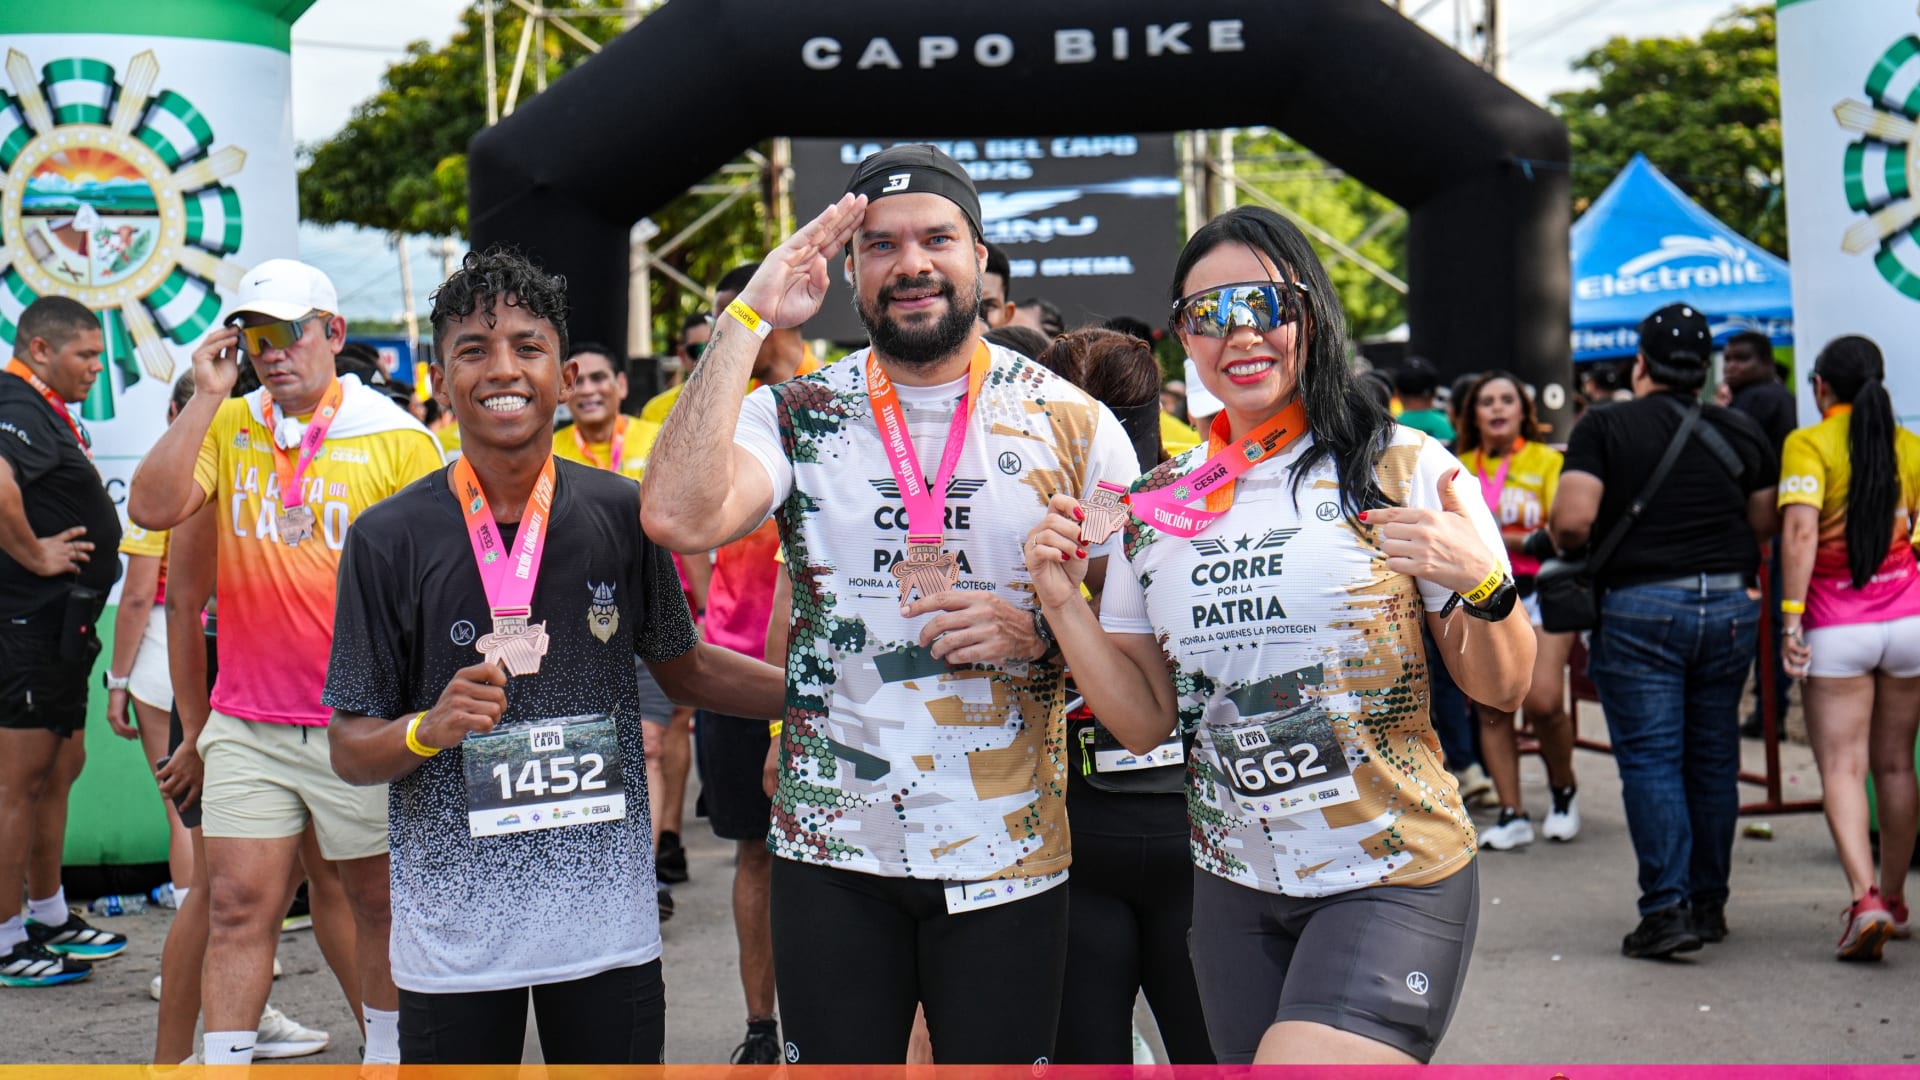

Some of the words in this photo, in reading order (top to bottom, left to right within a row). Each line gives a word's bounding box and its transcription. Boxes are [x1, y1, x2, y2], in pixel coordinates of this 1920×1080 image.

[801, 34, 1014, 70] CAPO
[1054, 19, 1245, 64] BIKE
[1050, 135, 1138, 158] CAPO
[1576, 259, 1769, 300] Electrolit
[881, 403, 908, 459] CAÑAGUATE
[234, 463, 259, 494] LA
[329, 483, 348, 498] DEL
[898, 458, 920, 497] EDICIÓN
[1194, 466, 1229, 491] CESAR
[1090, 496, 1116, 509] CAPO
[232, 493, 349, 551] CAO
[873, 506, 971, 531] CORE
[1154, 507, 1193, 531] EDICIÓN
[910, 553, 938, 563] CAPO
[1191, 553, 1284, 587] CORRE
[848, 578, 884, 588] HONRA
[887, 580, 895, 588] A
[1217, 585, 1238, 597] POR
[1241, 584, 1253, 594] LA
[1192, 595, 1287, 629] PATRIA
[496, 625, 526, 636] CAPO
[1180, 636, 1206, 646] HONRA
[1216, 628, 1253, 641] QUIENES
[1254, 627, 1265, 636] LA
[1266, 624, 1317, 635] PROTEGEN
[534, 734, 561, 748] CAPO
[1239, 733, 1266, 748] CAPO
[492, 753, 607, 800] 1452
[1222, 743, 1328, 791] 1662
[590, 806, 611, 815] CESAR
